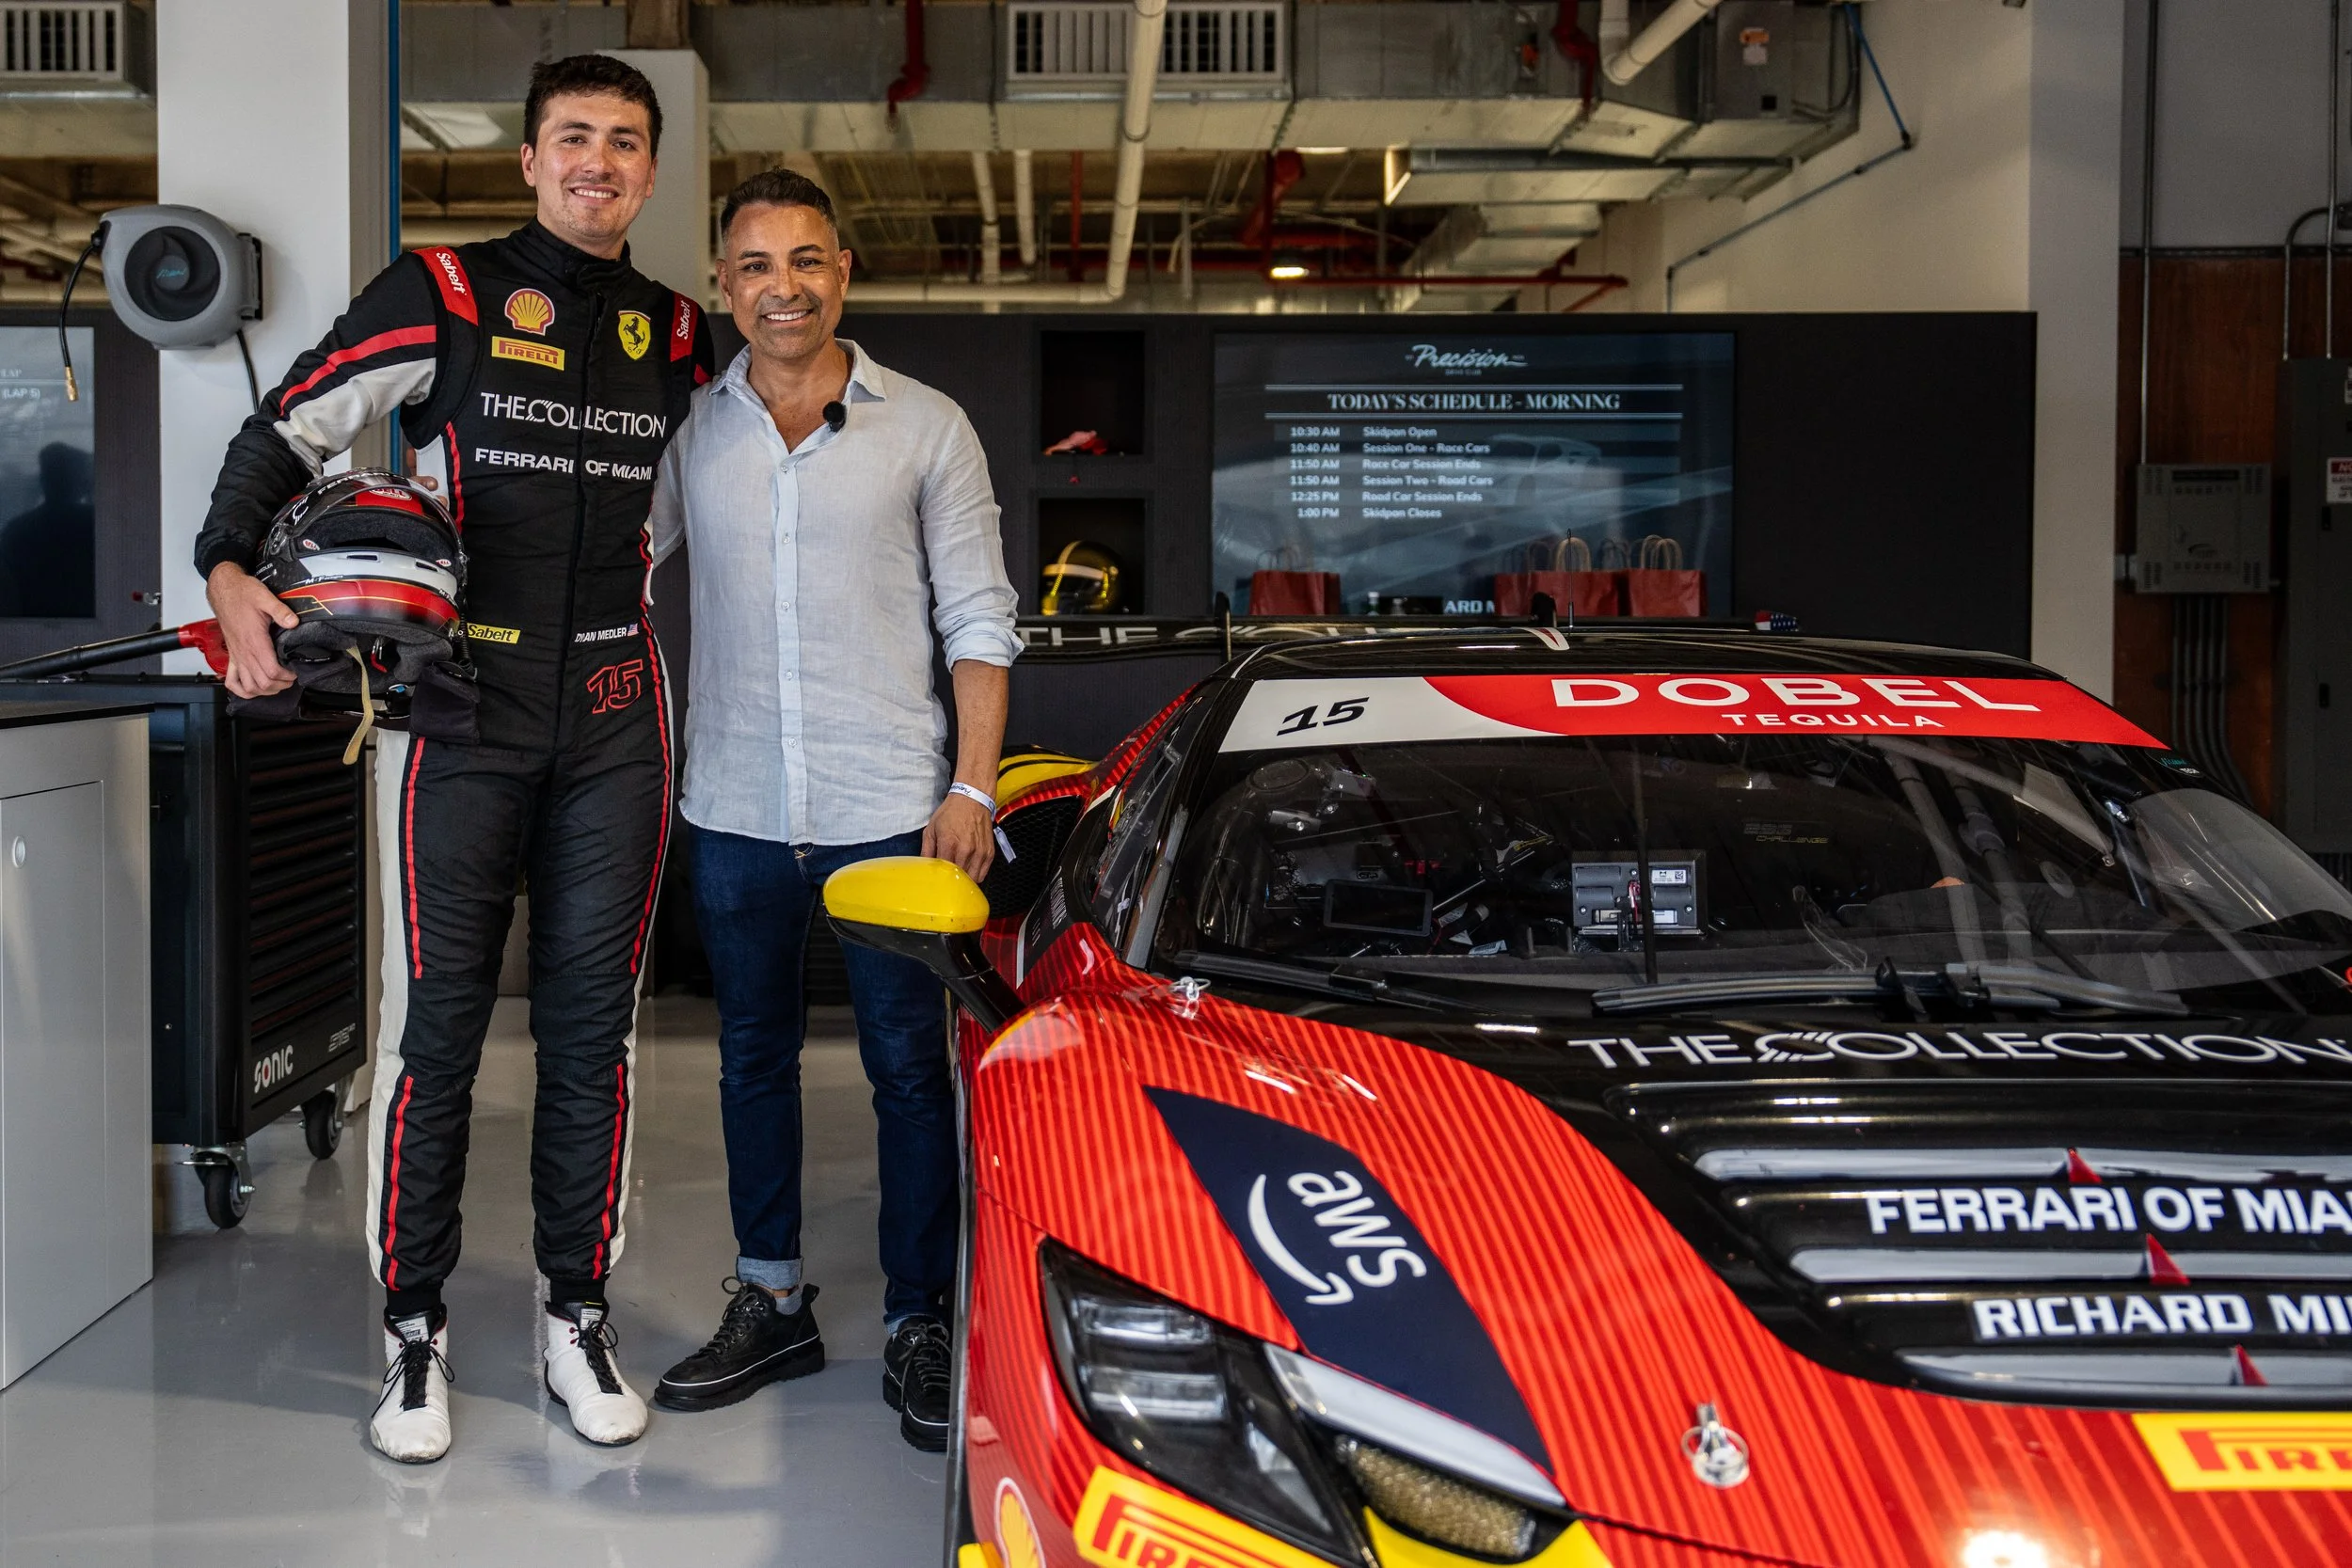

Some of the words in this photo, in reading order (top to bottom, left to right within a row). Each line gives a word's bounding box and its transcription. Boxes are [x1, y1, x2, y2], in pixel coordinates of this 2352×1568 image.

[437, 252, 467, 295] Sabelt
[676, 300, 691, 340] Sabelt
[499, 340, 559, 365] PIRELLI
[1411, 343, 1529, 368] Precision
[1327, 393, 1406, 409] TODAY'S
[1411, 393, 1513, 409] SCHEDULE
[1526, 393, 1621, 409] MORNING
[1291, 426, 1320, 437] 10:30
[1321, 426, 1341, 437] AM
[1407, 426, 1438, 440] Open
[1321, 443, 1341, 453] AM
[1363, 442, 1404, 453] Session
[1406, 442, 1426, 453] One
[1437, 442, 1464, 453] Race
[1465, 442, 1490, 453] Cars
[474, 447, 575, 473] FERRARI
[585, 459, 610, 475] OF
[612, 463, 653, 480] MIAMI
[1321, 459, 1341, 469] AM
[1363, 458, 1391, 469] Race
[1391, 458, 1411, 469] Car
[1412, 458, 1454, 469] Session
[1455, 458, 1482, 469] Ends
[1321, 475, 1341, 486] AM
[1363, 475, 1404, 485] Session
[1406, 475, 1429, 485] Two
[1438, 475, 1467, 485] Road
[1468, 475, 1494, 485] Cars
[1322, 491, 1340, 502] PM
[1362, 491, 1391, 502] Road
[1392, 491, 1412, 502] Car
[1414, 491, 1454, 502] Session
[1456, 491, 1483, 502] Ends
[1297, 507, 1321, 518] 1:00
[1322, 507, 1340, 518] PM
[1407, 507, 1443, 518] Closes
[469, 625, 514, 641] Sabelt
[597, 627, 628, 641] MEDLER
[585, 658, 644, 715] 15
[1550, 677, 2042, 712] DOBEL
[1276, 696, 1371, 736] 15
[1721, 713, 1947, 728] TEQUILA
[254, 1044, 294, 1094] SONIC
[1866, 1187, 2136, 1235] FERRARI
[2144, 1187, 2227, 1233] OF
[2233, 1188, 2352, 1235] MIA
[1287, 1170, 1427, 1288] aws
[1973, 1294, 2255, 1339] RICHARD
